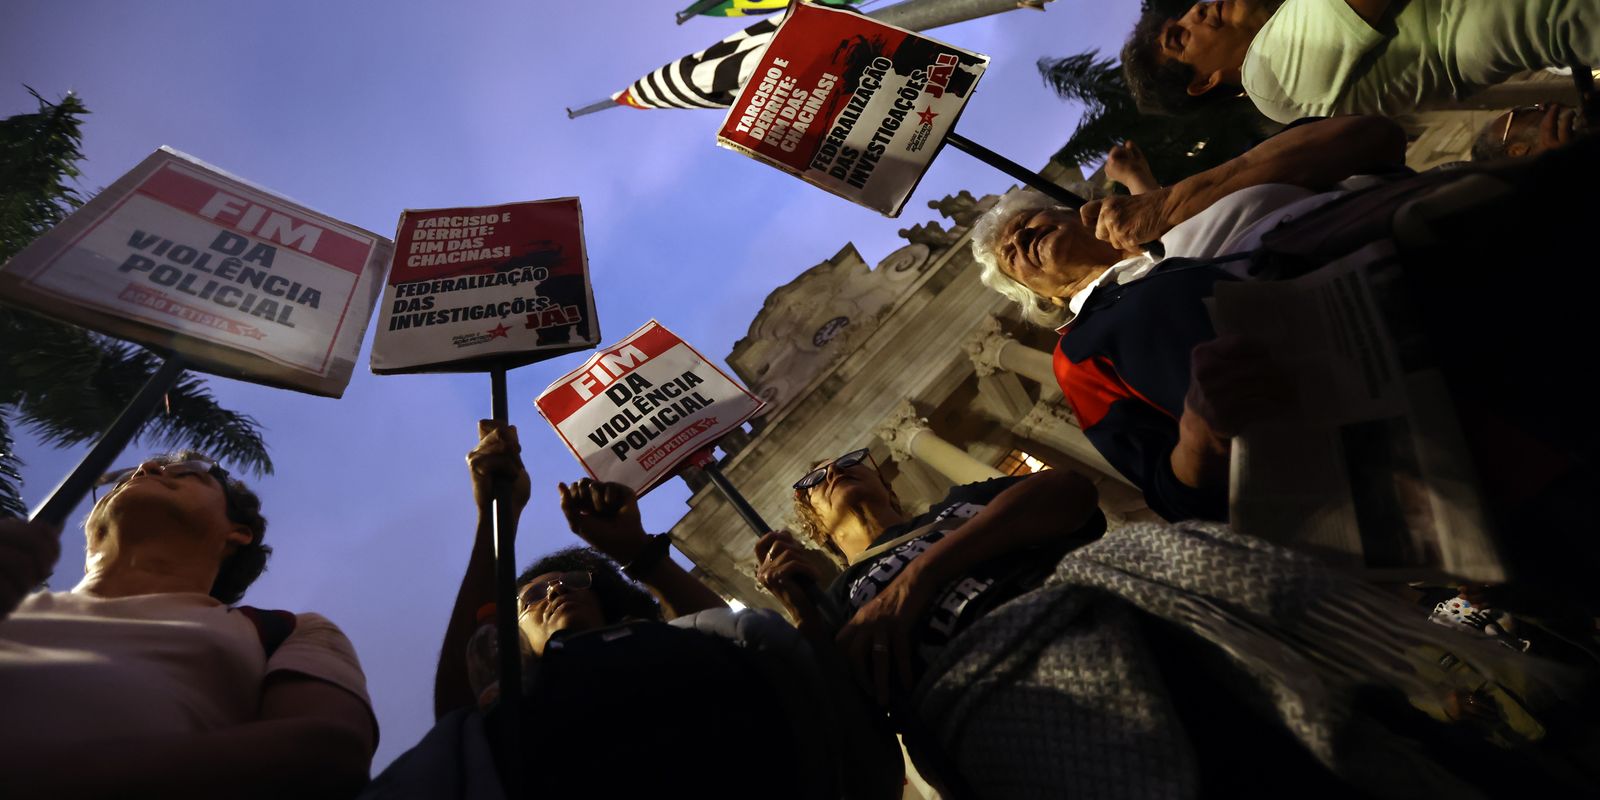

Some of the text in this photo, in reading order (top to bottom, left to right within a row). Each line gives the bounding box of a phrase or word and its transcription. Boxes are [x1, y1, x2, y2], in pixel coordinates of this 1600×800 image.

[736, 57, 789, 133] TARCISIO E
[924, 53, 959, 99] JÁ!
[749, 76, 797, 140] DERRITE:
[764, 88, 809, 147] FIM DAS
[780, 72, 839, 153] CHACINAS!
[810, 57, 893, 172] FEDERALIZAÇÃO
[847, 69, 929, 190] INVESTIGAÇÕES
[829, 147, 861, 182] DAS
[200, 191, 323, 254] FIM
[412, 226, 494, 241] DERRITE:
[416, 212, 511, 228] TARCISIO E
[210, 230, 278, 268] DA
[407, 246, 511, 267] CHACINAS!
[410, 237, 485, 254] FIM DAS
[118, 254, 295, 328] POLICIAL
[127, 229, 321, 309] VIOLÊNCIA
[395, 266, 549, 298] FEDERALIZAÇÃO
[169, 304, 229, 330] PETISTA
[389, 297, 550, 331] INVESTIGAÇÕES
[392, 296, 435, 314] DAS
[525, 304, 581, 330] JÁ!
[570, 343, 649, 401] FIM
[605, 372, 653, 407] DA
[587, 370, 704, 448] VIOLÊNCIA
[611, 391, 715, 462] POLICIAL
[643, 449, 666, 470] AÇÃO
[664, 427, 698, 452] PETISTA
